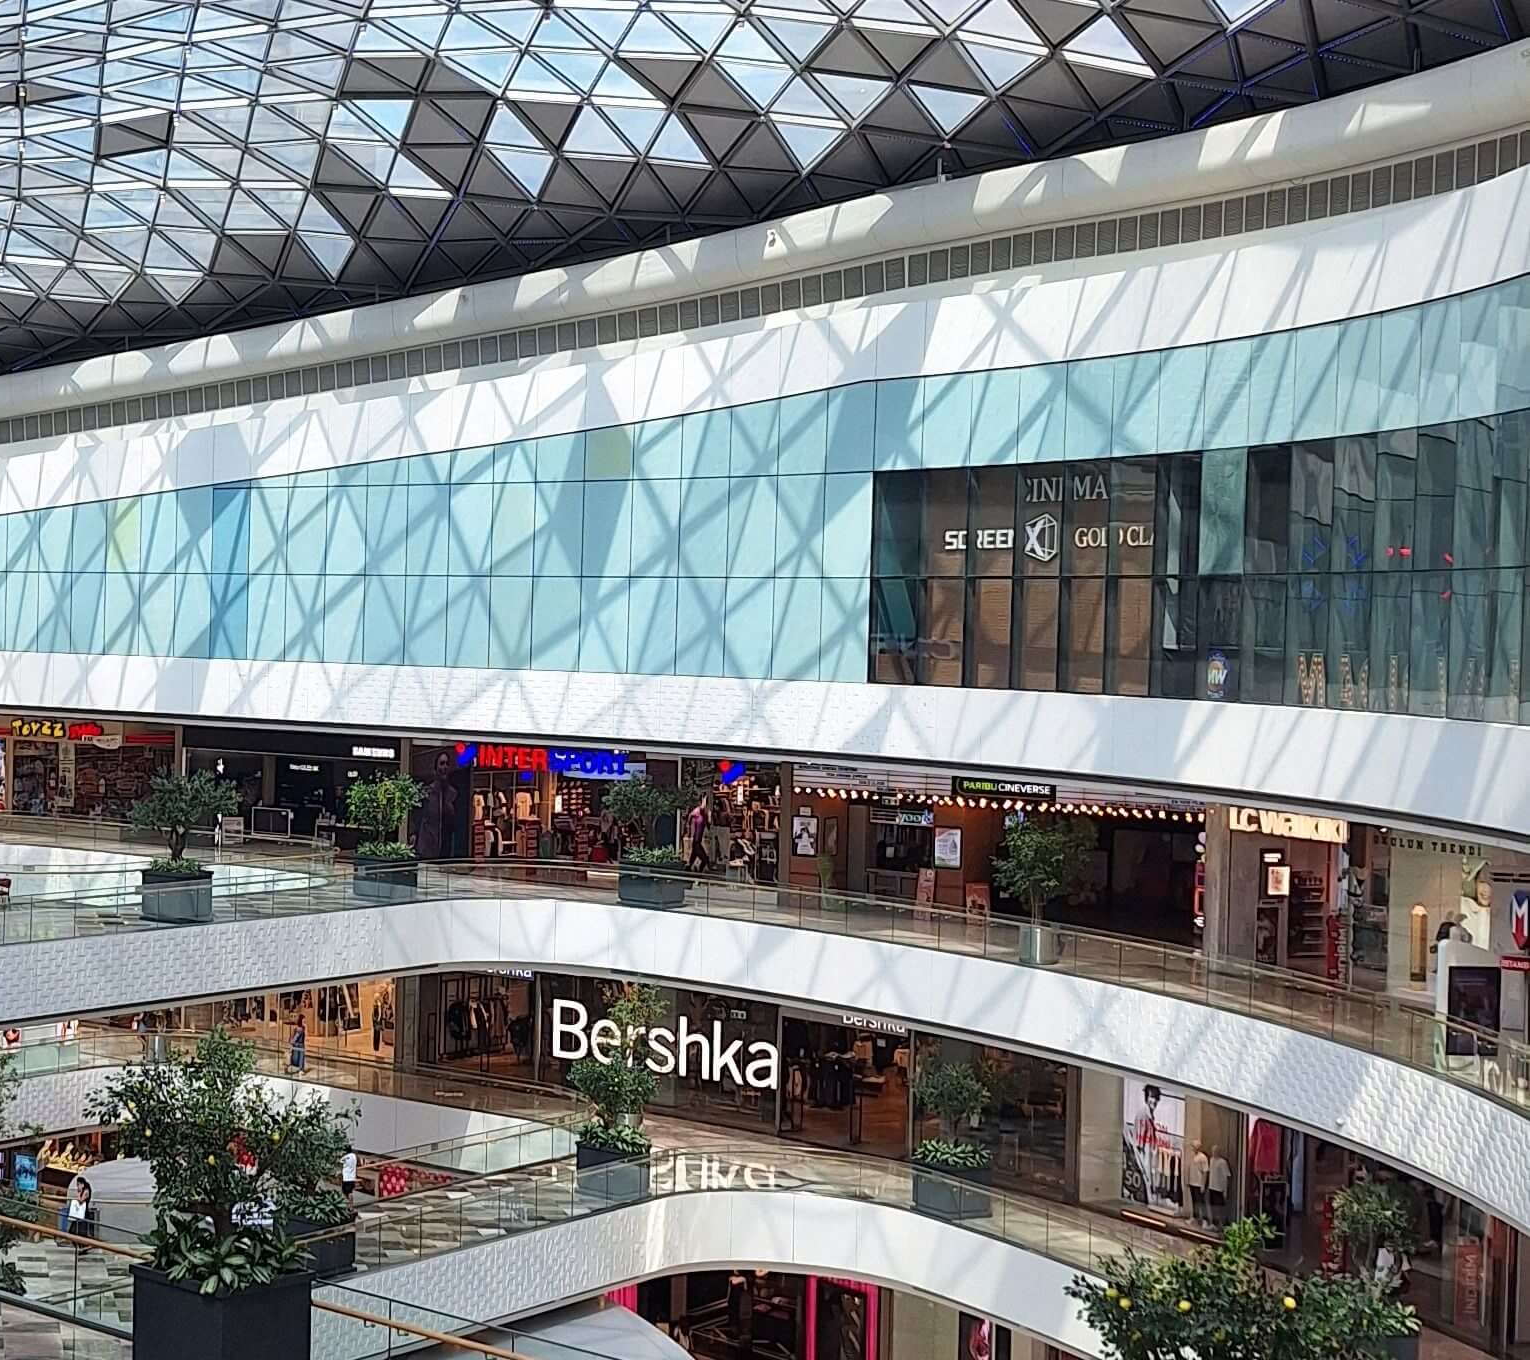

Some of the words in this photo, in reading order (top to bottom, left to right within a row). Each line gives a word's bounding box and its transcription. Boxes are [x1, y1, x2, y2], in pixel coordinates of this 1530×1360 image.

[998, 783, 1051, 795] CINEVERSE
[1229, 806, 1258, 832] LC
[552, 998, 779, 1091] Bershka
